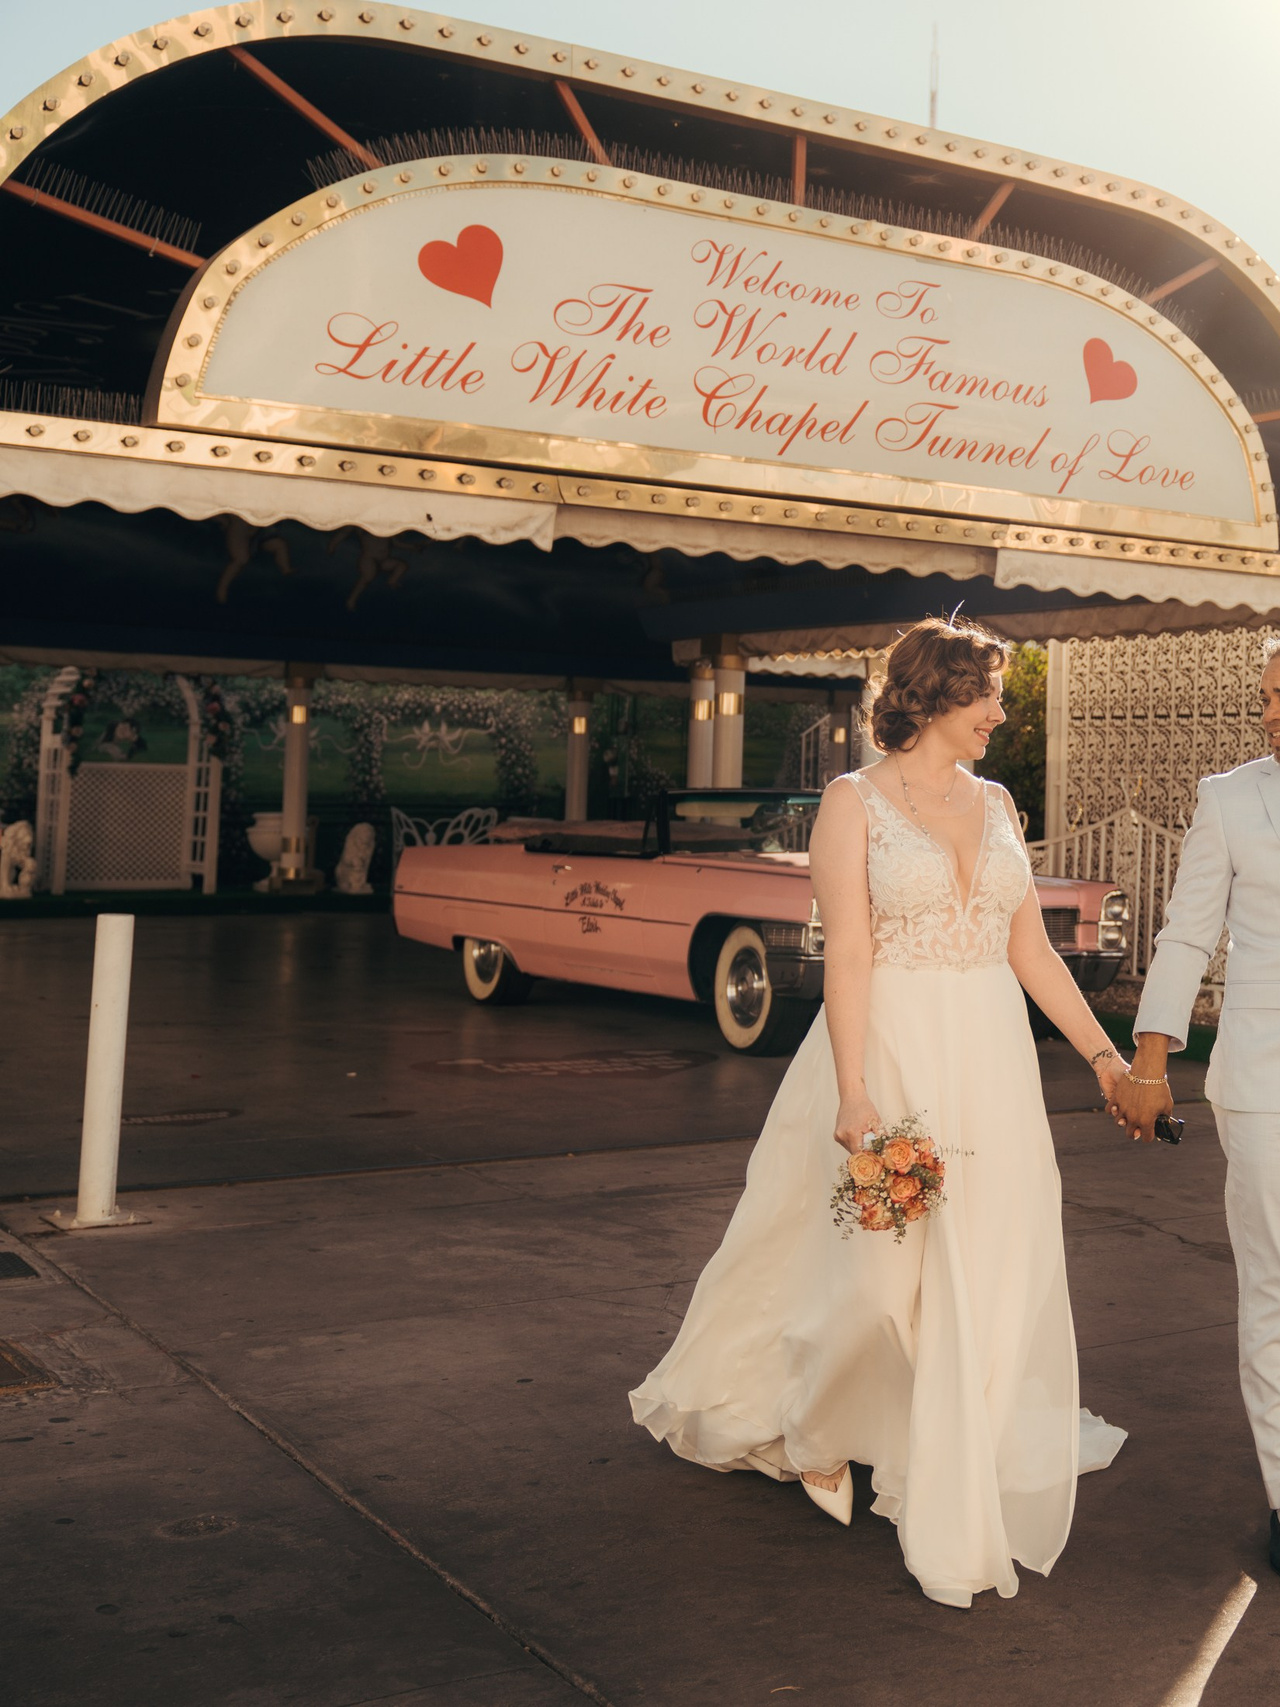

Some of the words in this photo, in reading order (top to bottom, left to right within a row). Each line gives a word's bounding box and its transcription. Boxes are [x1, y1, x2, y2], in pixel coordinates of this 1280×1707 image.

[691, 239, 861, 311] Welcome
[875, 280, 942, 324] To
[314, 311, 486, 395] Little
[510, 340, 668, 420] White
[692, 364, 871, 456] Chapel
[873, 401, 1053, 471] Tunnel
[1050, 432, 1101, 495] of
[1098, 428, 1196, 492] Love
[553, 283, 672, 348] The
[692, 299, 858, 377] World
[869, 335, 1050, 409] Famous
